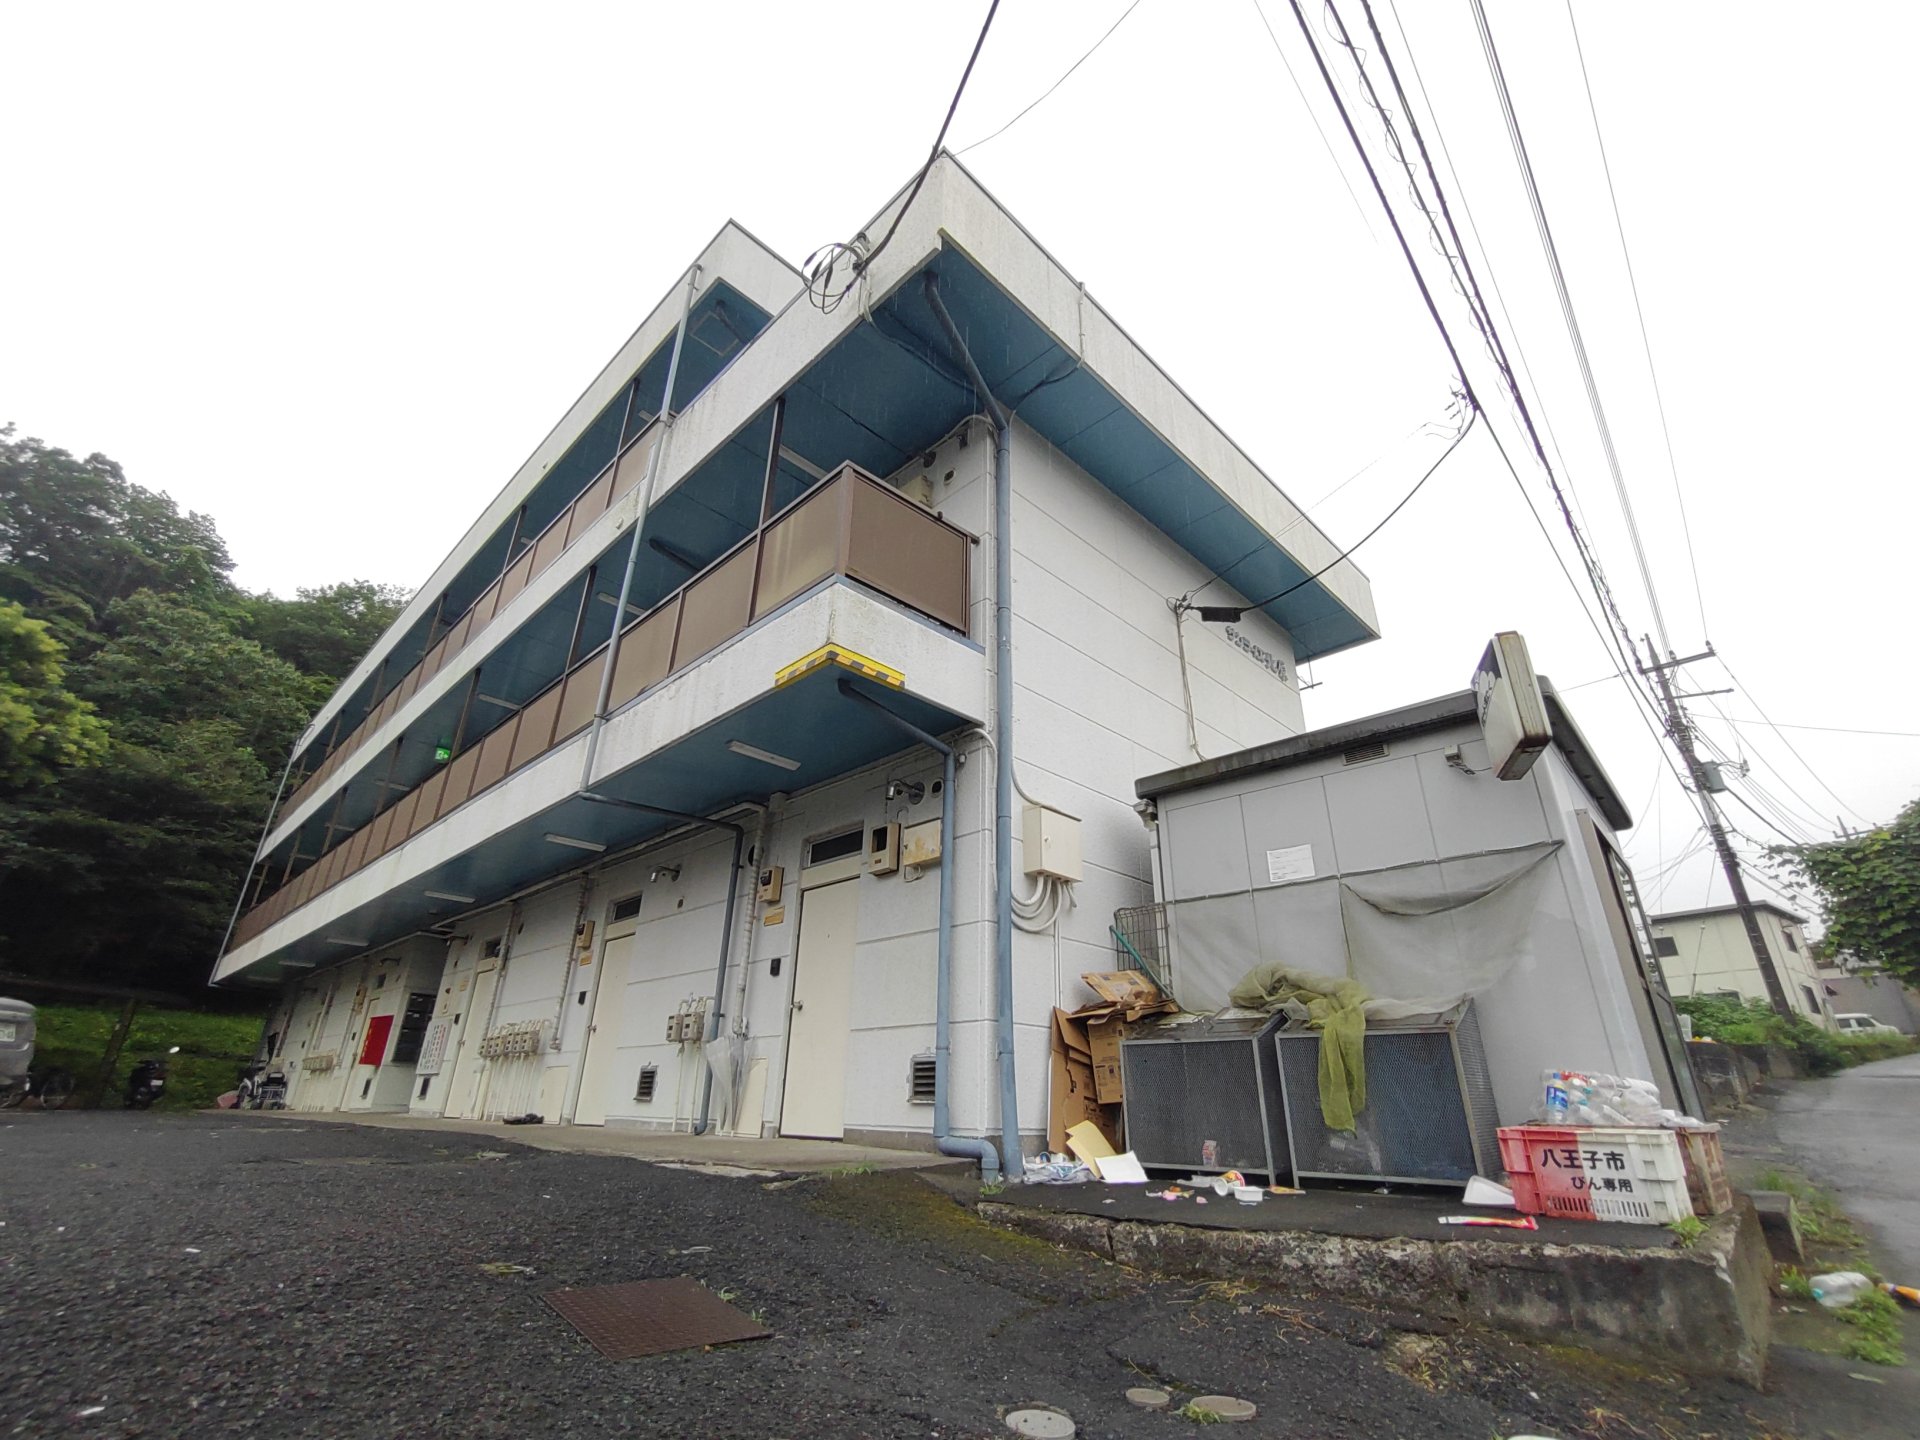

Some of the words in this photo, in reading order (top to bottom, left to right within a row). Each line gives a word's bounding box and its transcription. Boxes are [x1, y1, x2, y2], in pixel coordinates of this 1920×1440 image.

[1541, 1148, 1626, 1171] 八王子市
[1571, 1176, 1633, 1193] びん専用
